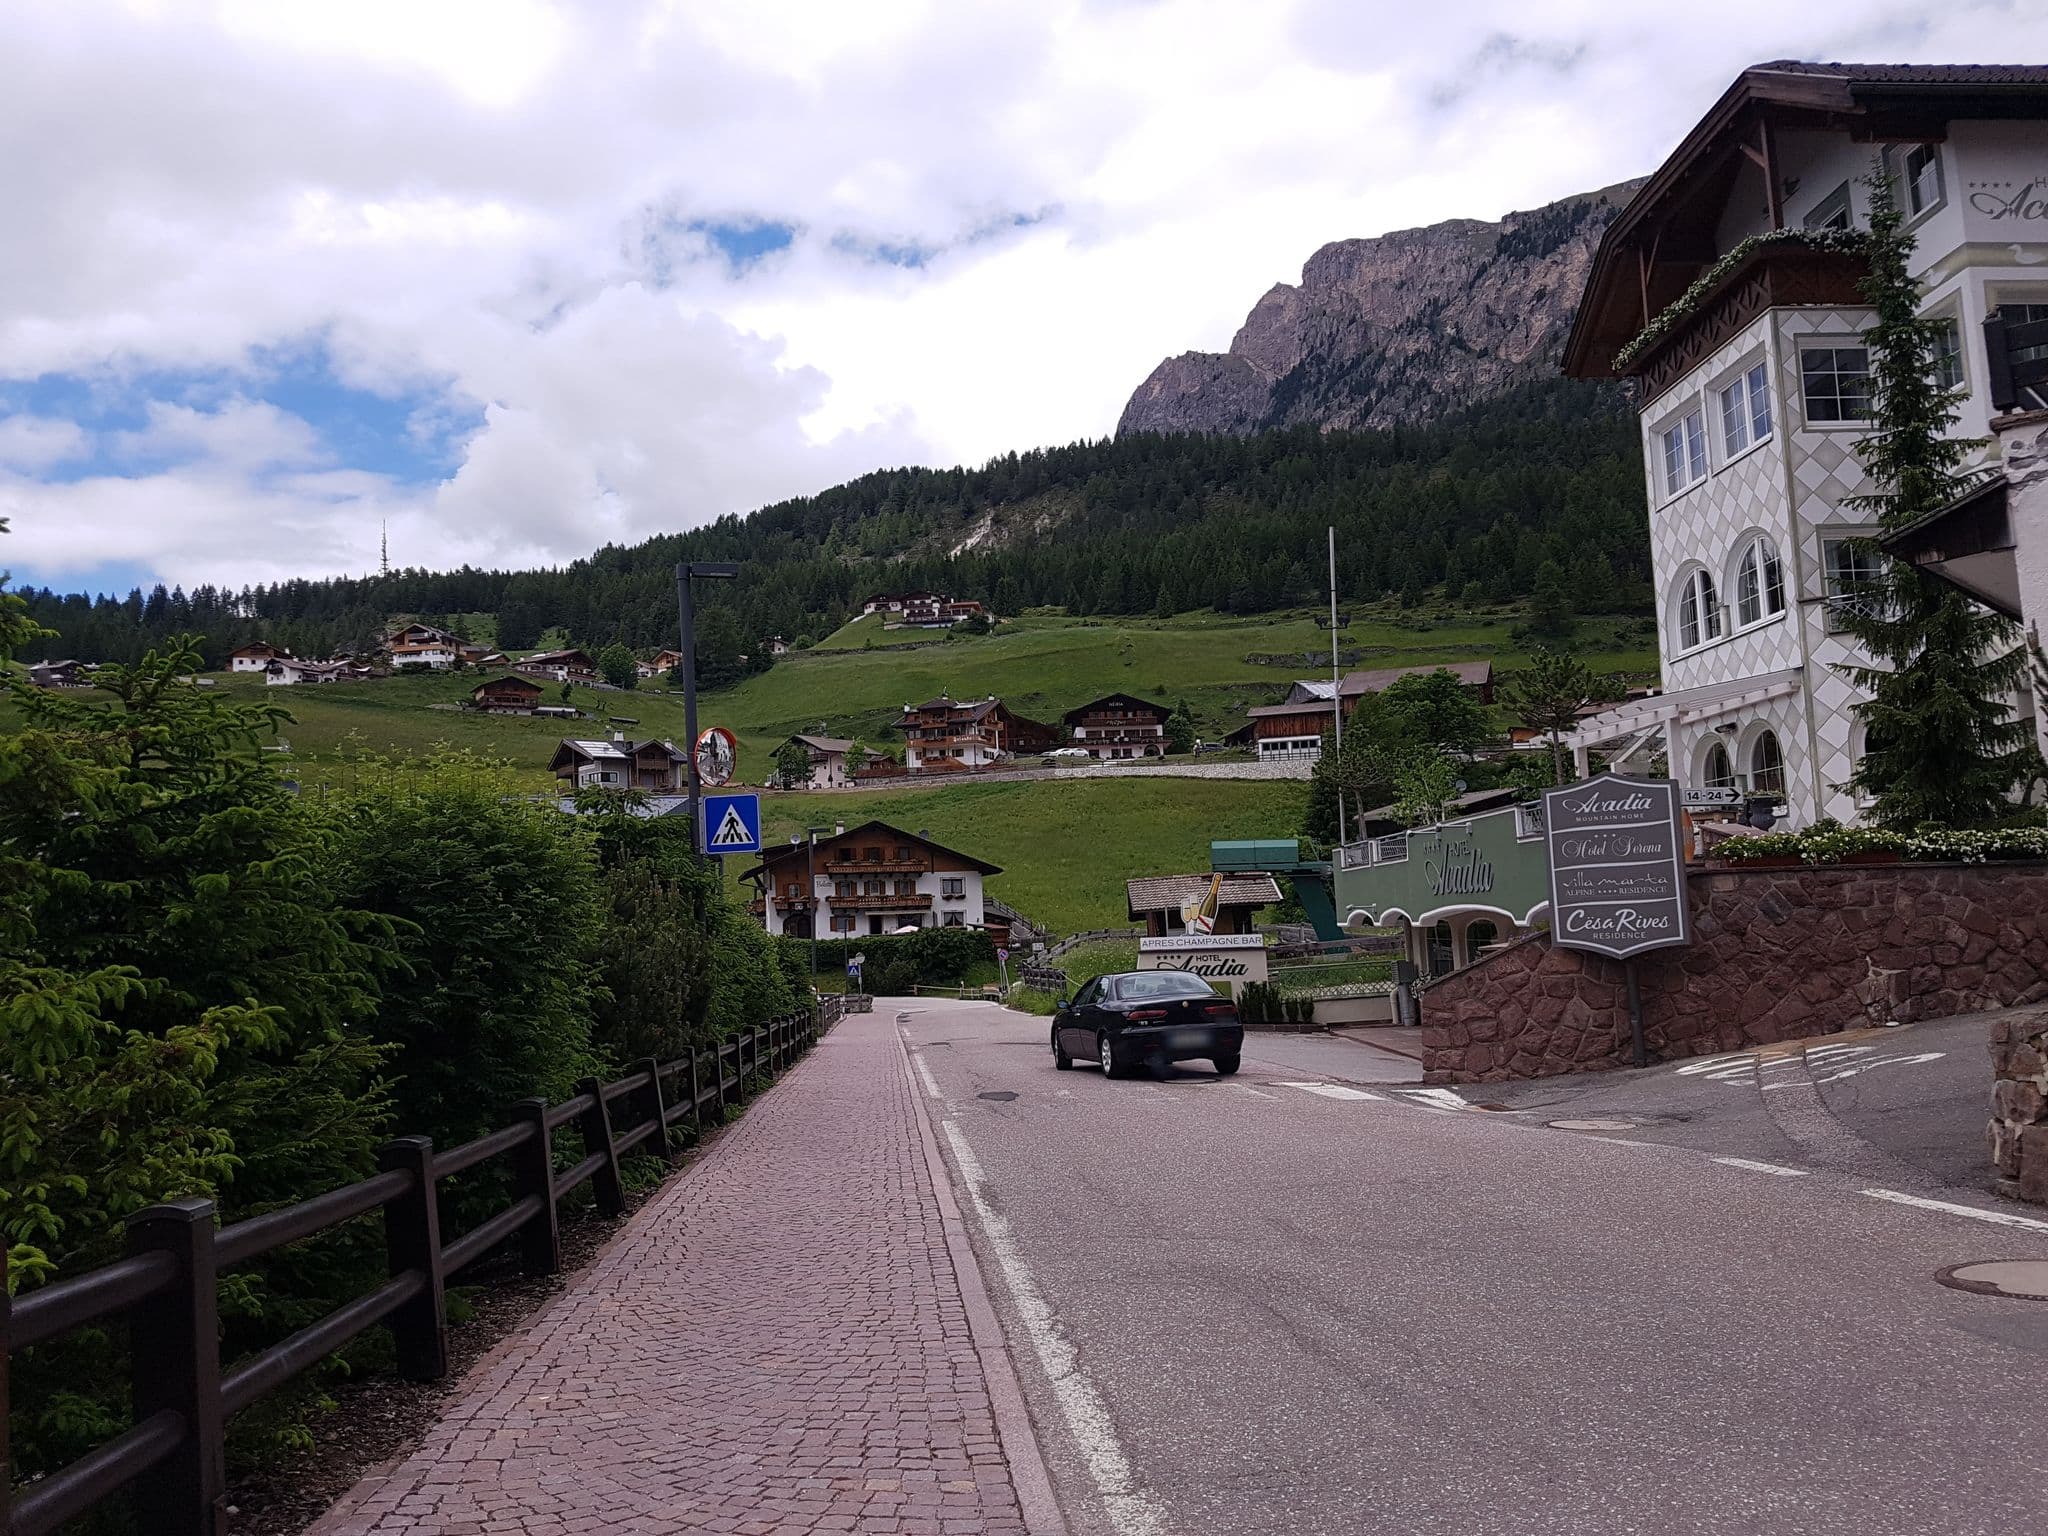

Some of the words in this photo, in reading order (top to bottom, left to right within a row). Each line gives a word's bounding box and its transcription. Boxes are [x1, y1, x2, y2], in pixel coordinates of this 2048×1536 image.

[1562, 791, 1653, 813] Acadia
[1575, 814, 1618, 822] MOUNTAIN
[1561, 839, 1607, 859] Hotel
[1611, 836, 1662, 857] Serena
[1424, 842, 1495, 896] Acadia
[1562, 871, 1594, 887] villa
[1598, 872, 1668, 886] marta
[1566, 888, 1595, 896] ALPINE
[1619, 886, 1667, 895] RESIDENCE
[1615, 908, 1670, 932] Rives
[1142, 939, 1175, 948] APRES
[1176, 937, 1241, 947] CHAMPAGNE
[1241, 936, 1263, 945] BAR
[1593, 931, 1648, 940] RESIDENCE
[1195, 954, 1222, 962] HOTEL
